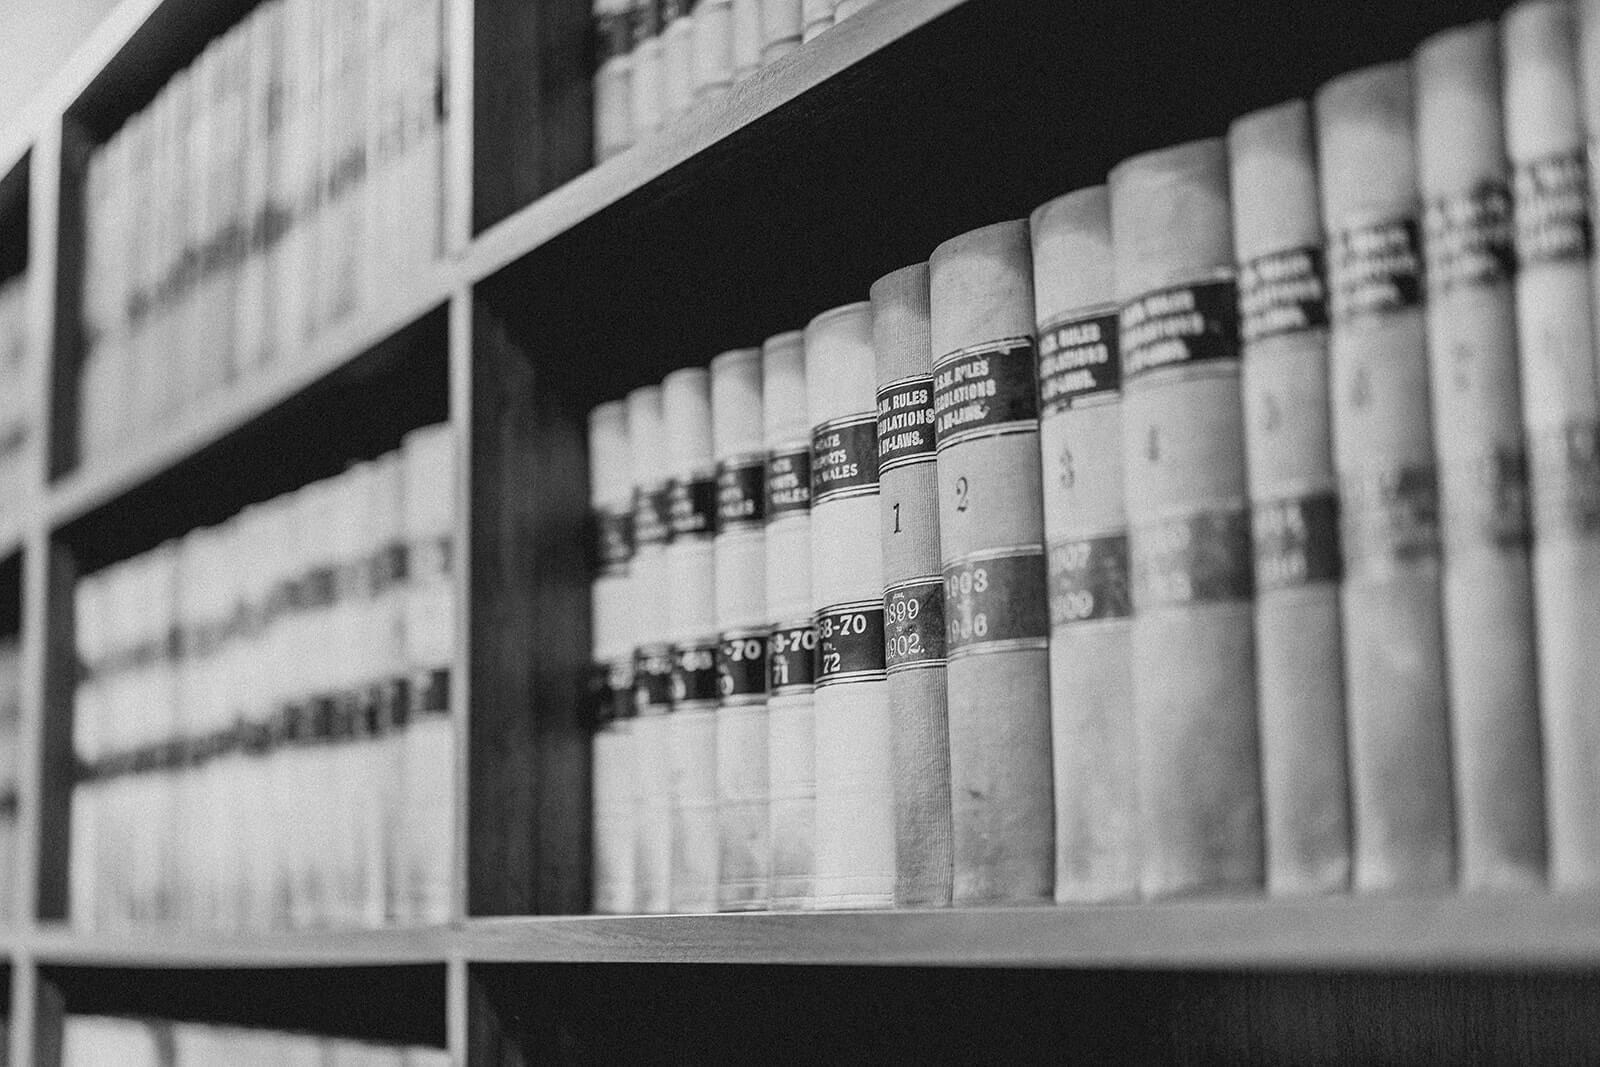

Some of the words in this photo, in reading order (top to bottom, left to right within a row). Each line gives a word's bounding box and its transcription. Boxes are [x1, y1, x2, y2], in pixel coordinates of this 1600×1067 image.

[893, 389, 928, 410] RULES
[821, 463, 859, 482] WALES
[956, 476, 968, 512] 2
[893, 503, 902, 535] 1
[886, 598, 919, 626] 1899
[823, 652, 841, 674] 72
